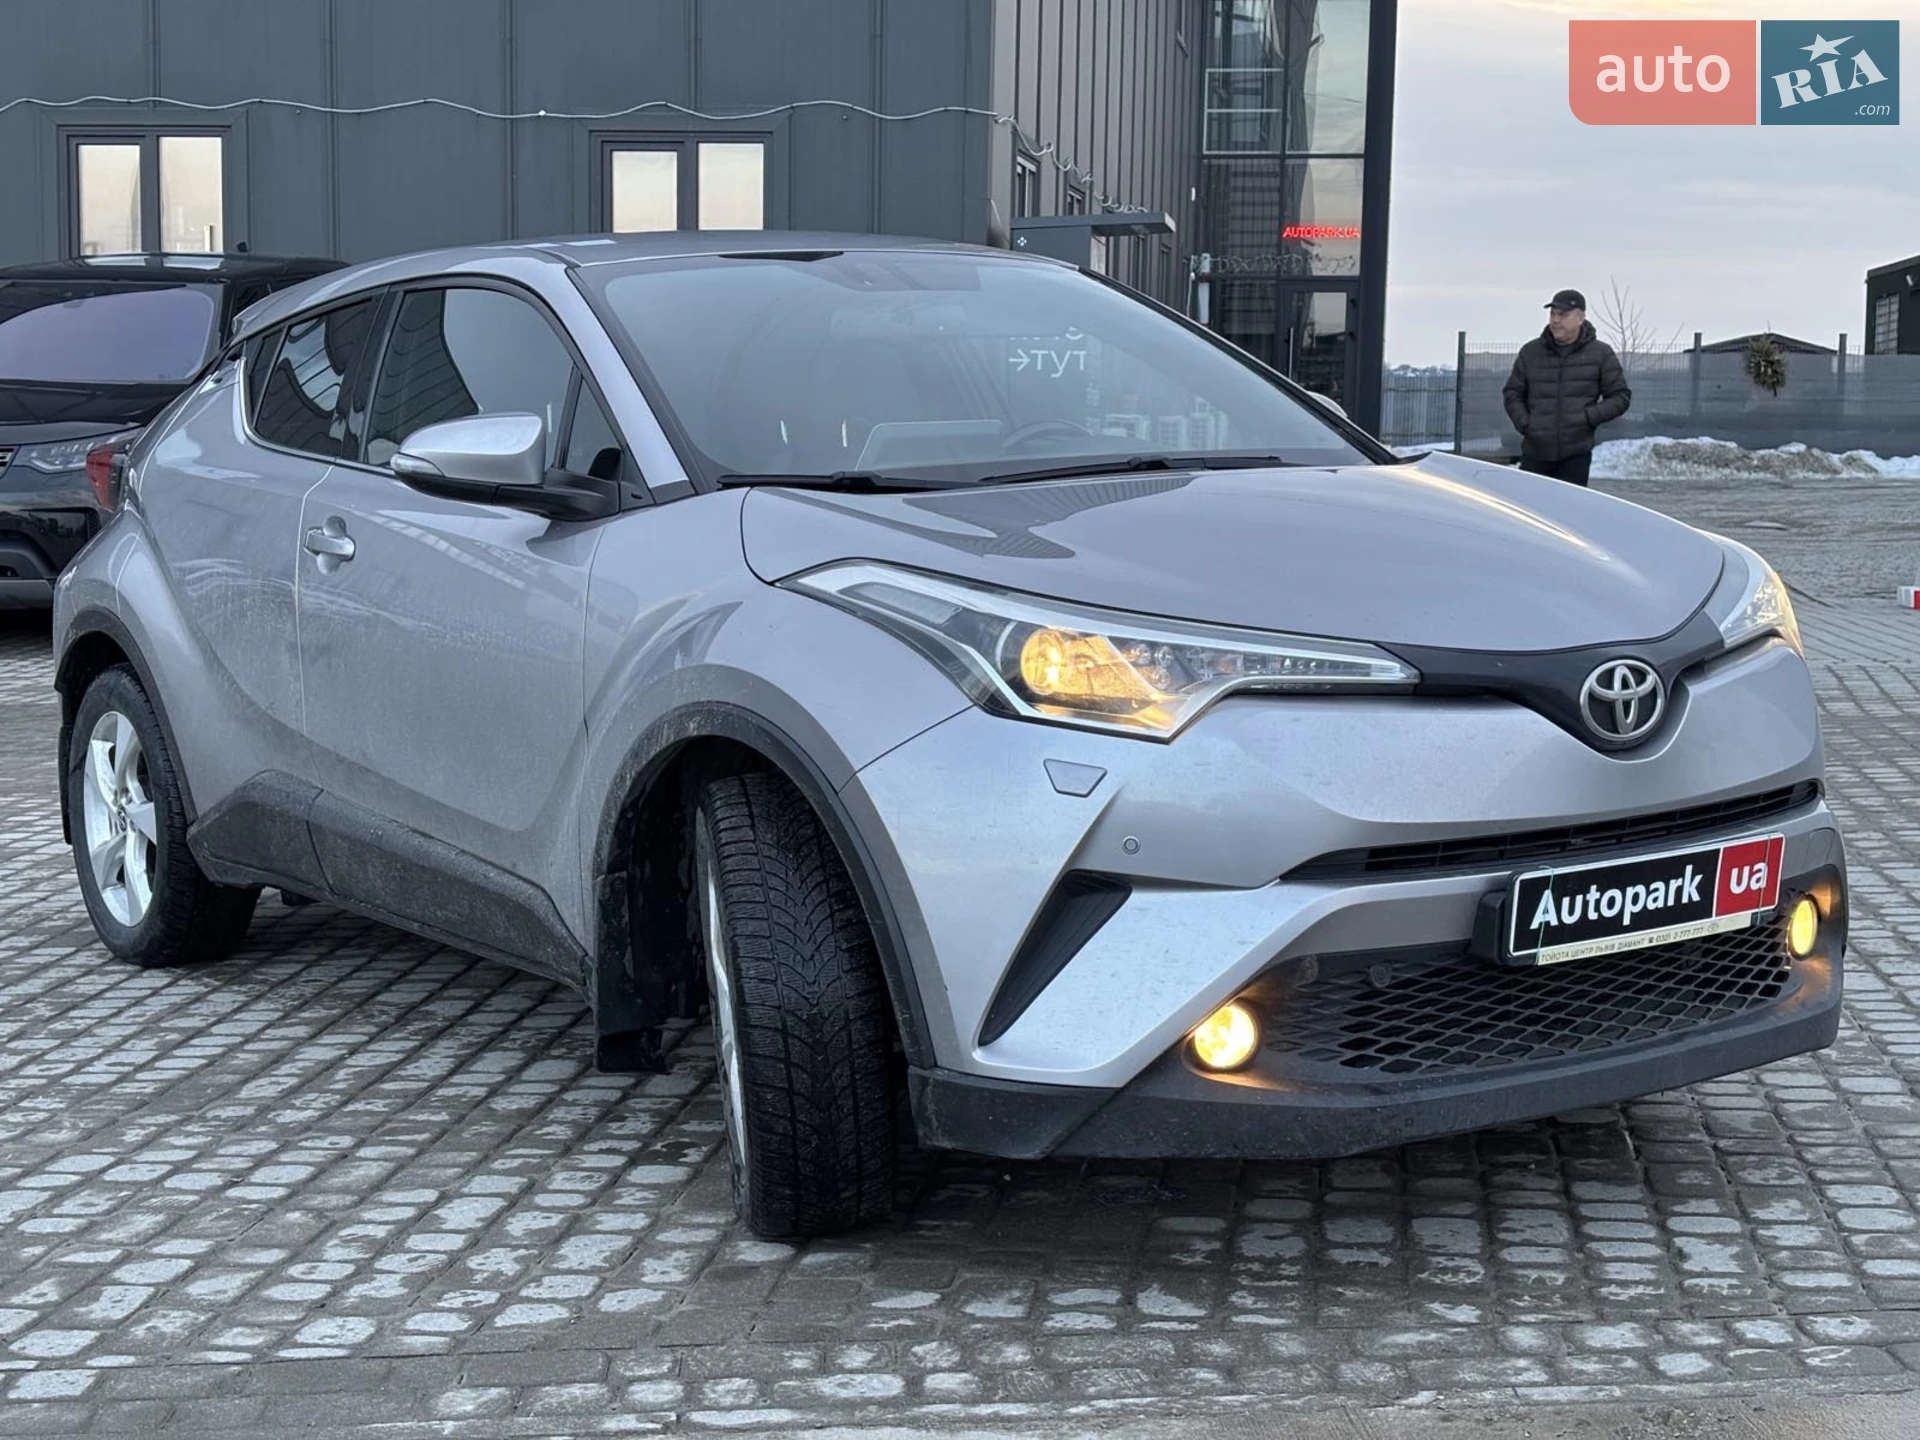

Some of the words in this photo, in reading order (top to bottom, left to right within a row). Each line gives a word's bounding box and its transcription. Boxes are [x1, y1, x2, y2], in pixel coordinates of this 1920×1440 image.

[1283, 226, 1361, 238] AUTOPARK.UA
[1529, 863, 1704, 930] Autopark
[1729, 861, 1769, 896] ua
